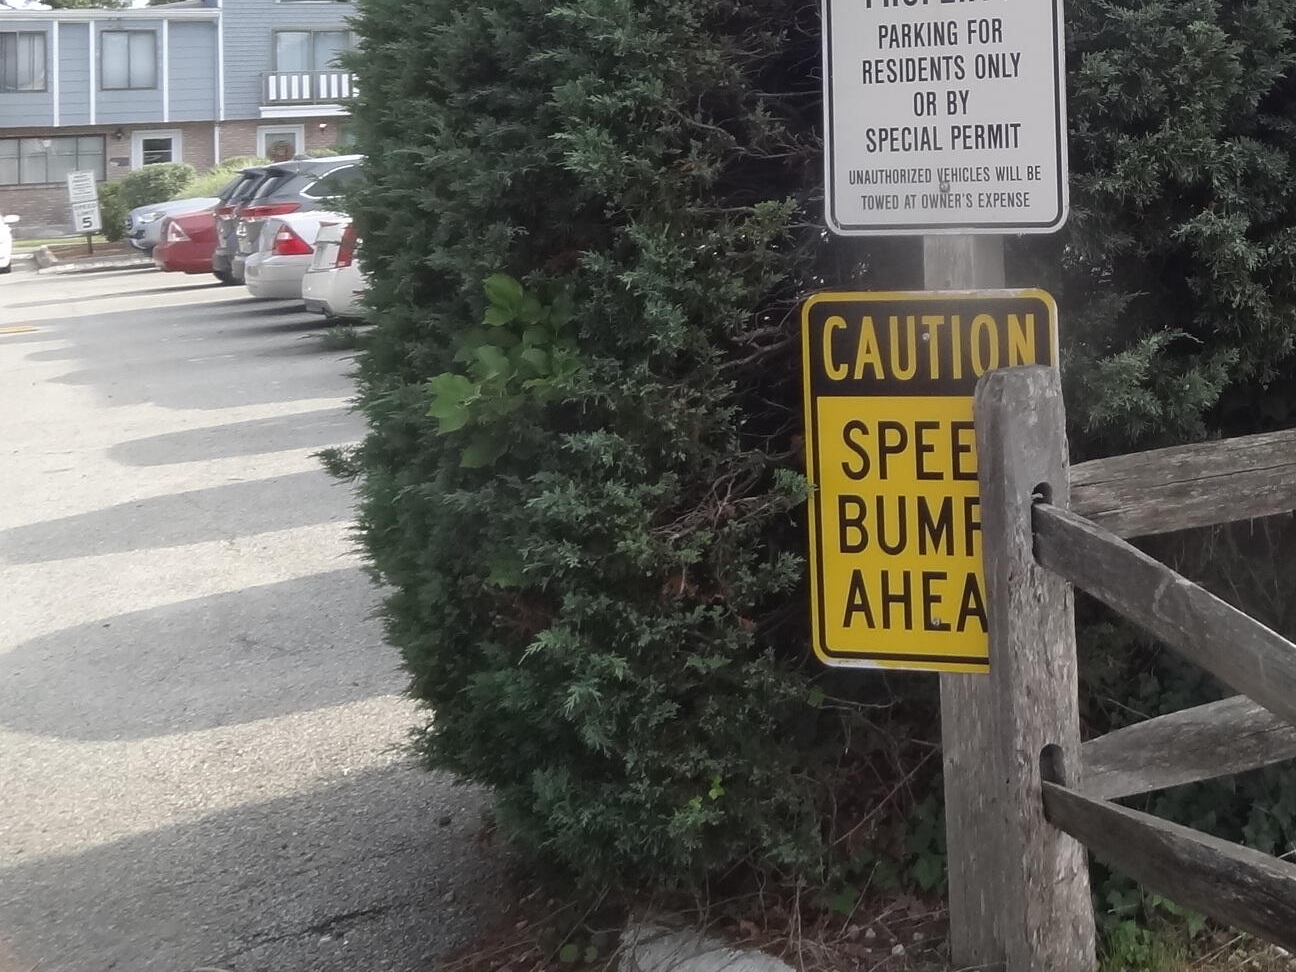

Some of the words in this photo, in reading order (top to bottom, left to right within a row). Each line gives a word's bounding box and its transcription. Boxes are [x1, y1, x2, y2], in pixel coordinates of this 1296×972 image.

[878, 20, 958, 49] PARKING
[967, 18, 1003, 45] FOR
[862, 55, 966, 84] RESIDENTS
[974, 52, 1021, 79] ONLY
[913, 91, 937, 117] OR
[946, 89, 969, 115] BY
[866, 126, 943, 153] SPECIAL
[951, 123, 1021, 150] PERMIT
[848, 168, 932, 185] UNAUTHORIZED
[936, 166, 991, 183] VEHICLES
[995, 165, 1022, 181] WILL
[1026, 165, 1042, 181] BE
[861, 194, 899, 210] TOWED
[904, 194, 916, 209] AT
[921, 192, 973, 209] OWNER'S
[978, 191, 1031, 208] EXPENSE
[82, 217, 92, 229] 5
[823, 313, 1036, 381] CAUTION
[842, 419, 978, 481] SPEE
[842, 568, 989, 634] AHEA
